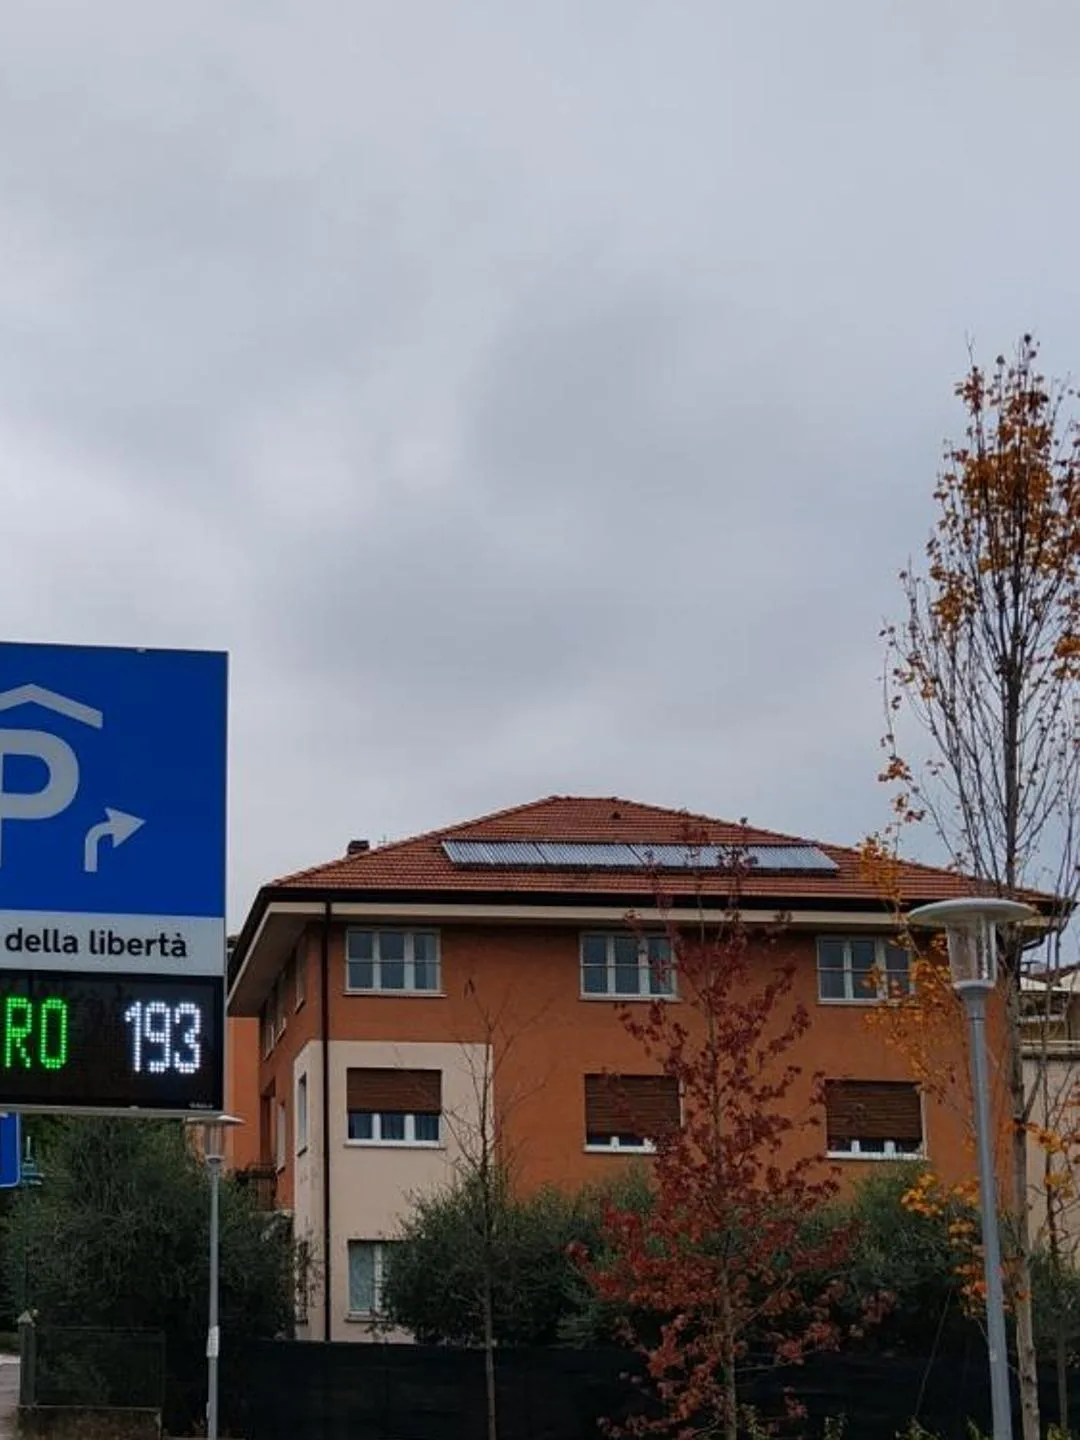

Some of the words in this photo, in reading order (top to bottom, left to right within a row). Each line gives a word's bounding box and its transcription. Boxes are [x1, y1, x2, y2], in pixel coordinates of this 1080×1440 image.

[5, 928, 78, 955] della
[89, 931, 188, 958] libertà
[125, 1001, 202, 1073] 193
